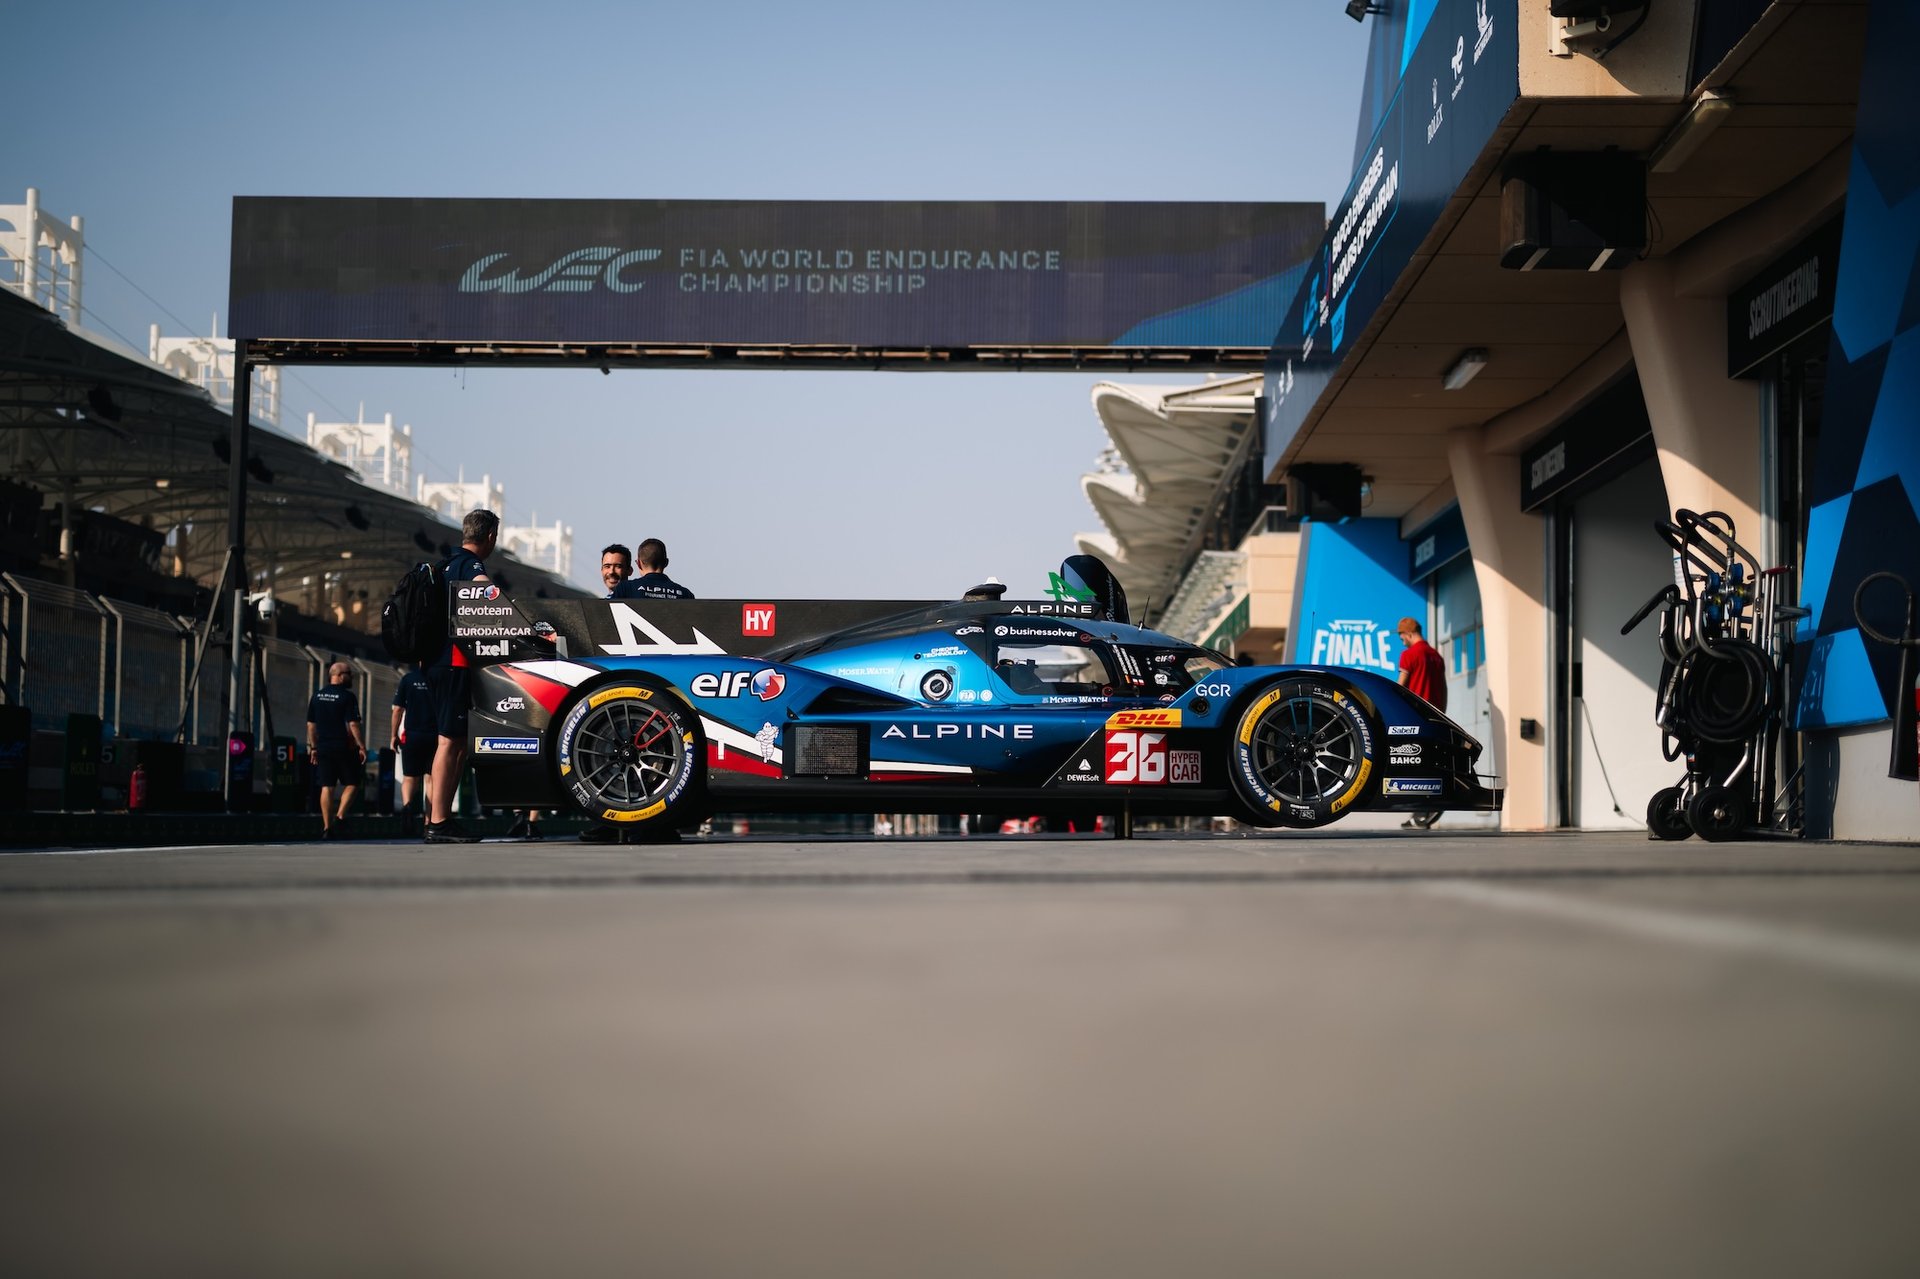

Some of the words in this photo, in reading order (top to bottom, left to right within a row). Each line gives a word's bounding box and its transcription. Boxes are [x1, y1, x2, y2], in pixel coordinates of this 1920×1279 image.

[679, 248, 729, 269] FIA
[739, 248, 854, 270] WORLD
[866, 249, 1060, 271] ENDURANCE
[458, 246, 662, 294] WEC
[679, 272, 926, 294] CHAMPIONSHIP
[1749, 255, 1819, 340] SCRUTINEERING
[458, 586, 485, 600] elf
[638, 585, 683, 596] ALPINE
[457, 605, 513, 616] devoteam
[1010, 604, 1092, 614] ALPINE
[745, 610, 773, 631] HY
[456, 627, 532, 636] EURODATACAR
[1009, 626, 1078, 638] businessolver
[475, 640, 509, 657] ixell
[923, 649, 968, 658] TECHNOLOGY
[1311, 629, 1396, 672] FINALE
[691, 672, 750, 697] elf
[1195, 684, 1231, 697] GCR
[1116, 713, 1172, 725] DHL
[561, 705, 587, 755] MICHELIN
[881, 724, 1034, 739] ALPINE
[1347, 705, 1372, 754] MICHELIN
[277, 745, 288, 762] 5
[492, 742, 538, 750] MICHELIN
[1107, 732, 1167, 782] 36
[1171, 753, 1199, 764] HYPER
[1390, 757, 1422, 765] BAHCO
[668, 752, 693, 801] MICHELIN
[1066, 774, 1100, 782] DEWESoft
[1171, 764, 1200, 781] CAR
[1241, 748, 1267, 797] MICHELIN
